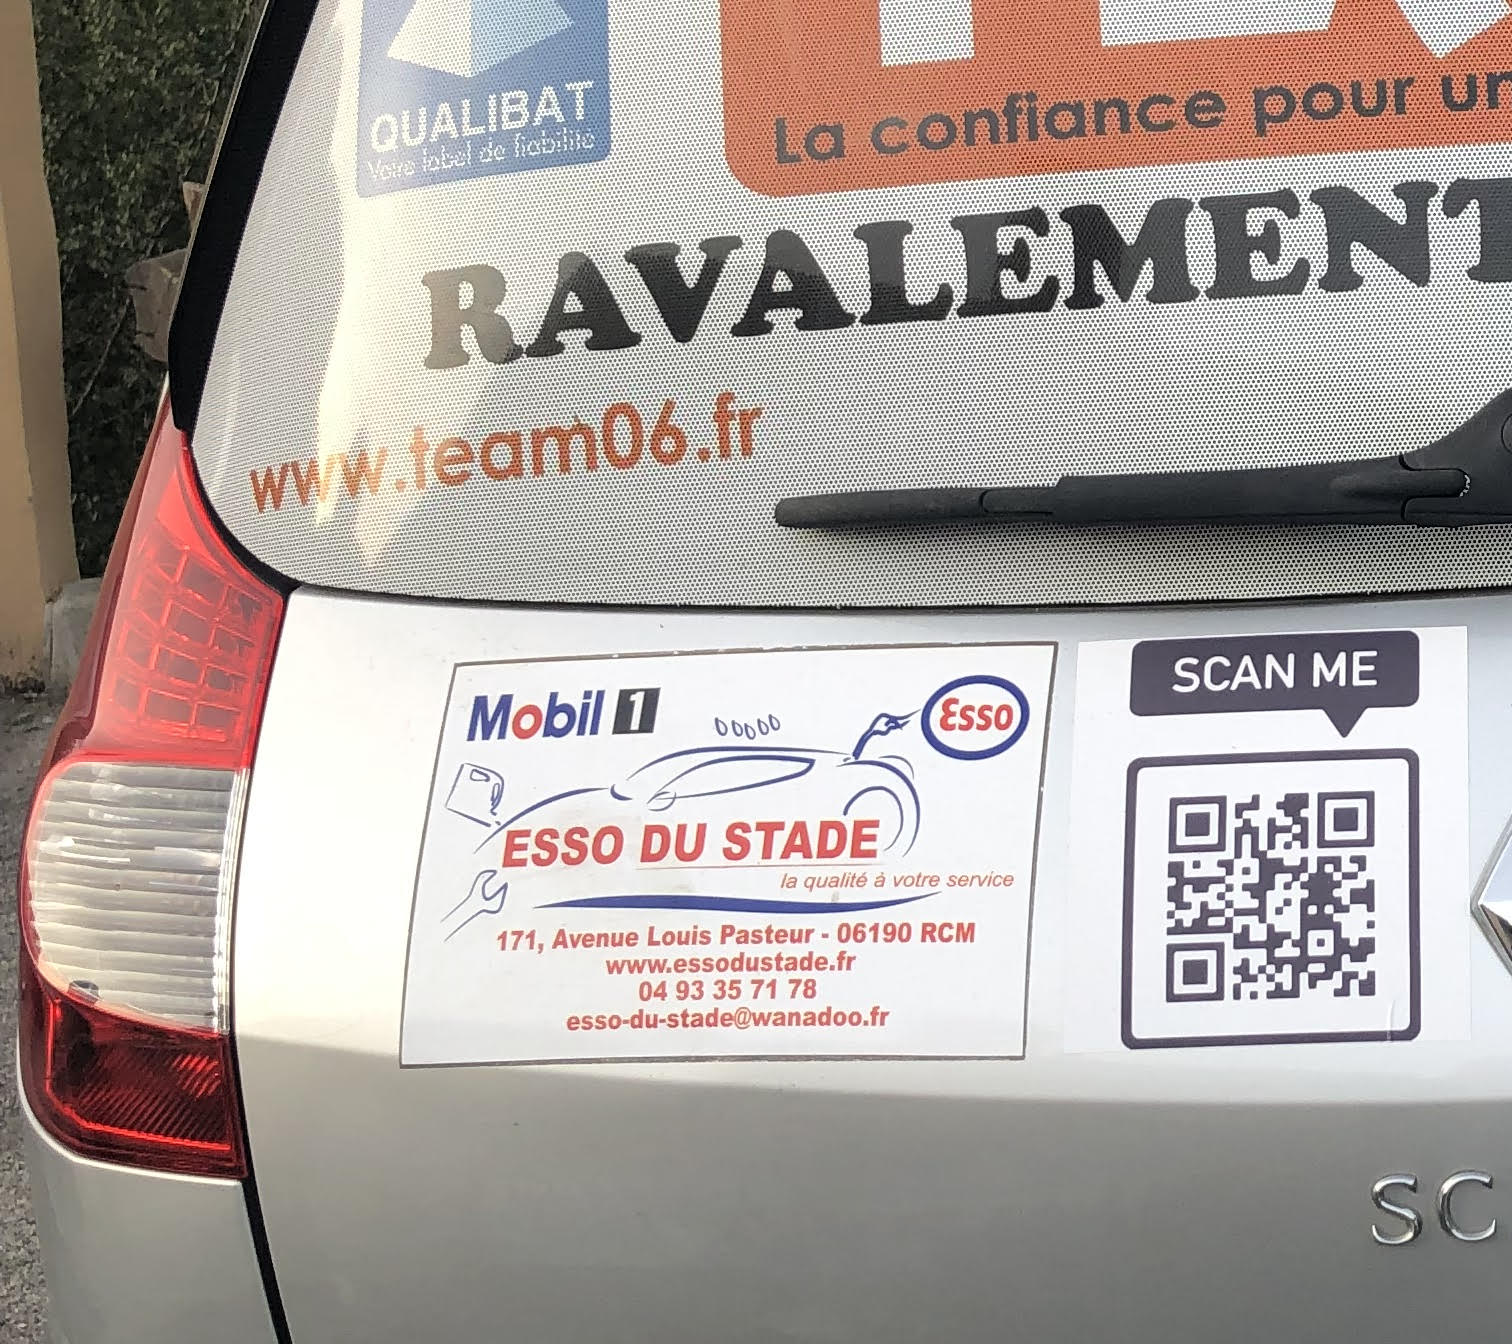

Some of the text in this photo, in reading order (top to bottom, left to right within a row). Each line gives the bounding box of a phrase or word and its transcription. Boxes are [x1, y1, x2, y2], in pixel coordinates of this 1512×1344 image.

[370, 80, 594, 154] QUALIBAT
[774, 116, 845, 164] La
[870, 91, 1226, 156] confiance
[1253, 75, 1415, 137] pour
[422, 140, 472, 173] label
[479, 136, 506, 163] de
[250, 391, 764, 515] www.team06.fr
[1171, 650, 1378, 693] SCAN ME
[466, 689, 606, 742] Mobil
[501, 819, 880, 868] ESSO DU STADE
[780, 871, 1015, 895] la qualité à votre service
[497, 929, 545, 954] 171,
[551, 928, 640, 950] Avenue
[647, 925, 712, 947] Louis
[719, 924, 815, 945] Pasteur
[836, 922, 912, 944] 06190
[920, 922, 976, 944] RCM
[605, 951, 857, 975] www.essodustade.fr
[638, 978, 817, 1002] 04 93 35 71 78
[566, 1006, 890, 1031] esso-du-stade@wanadoo.fr
